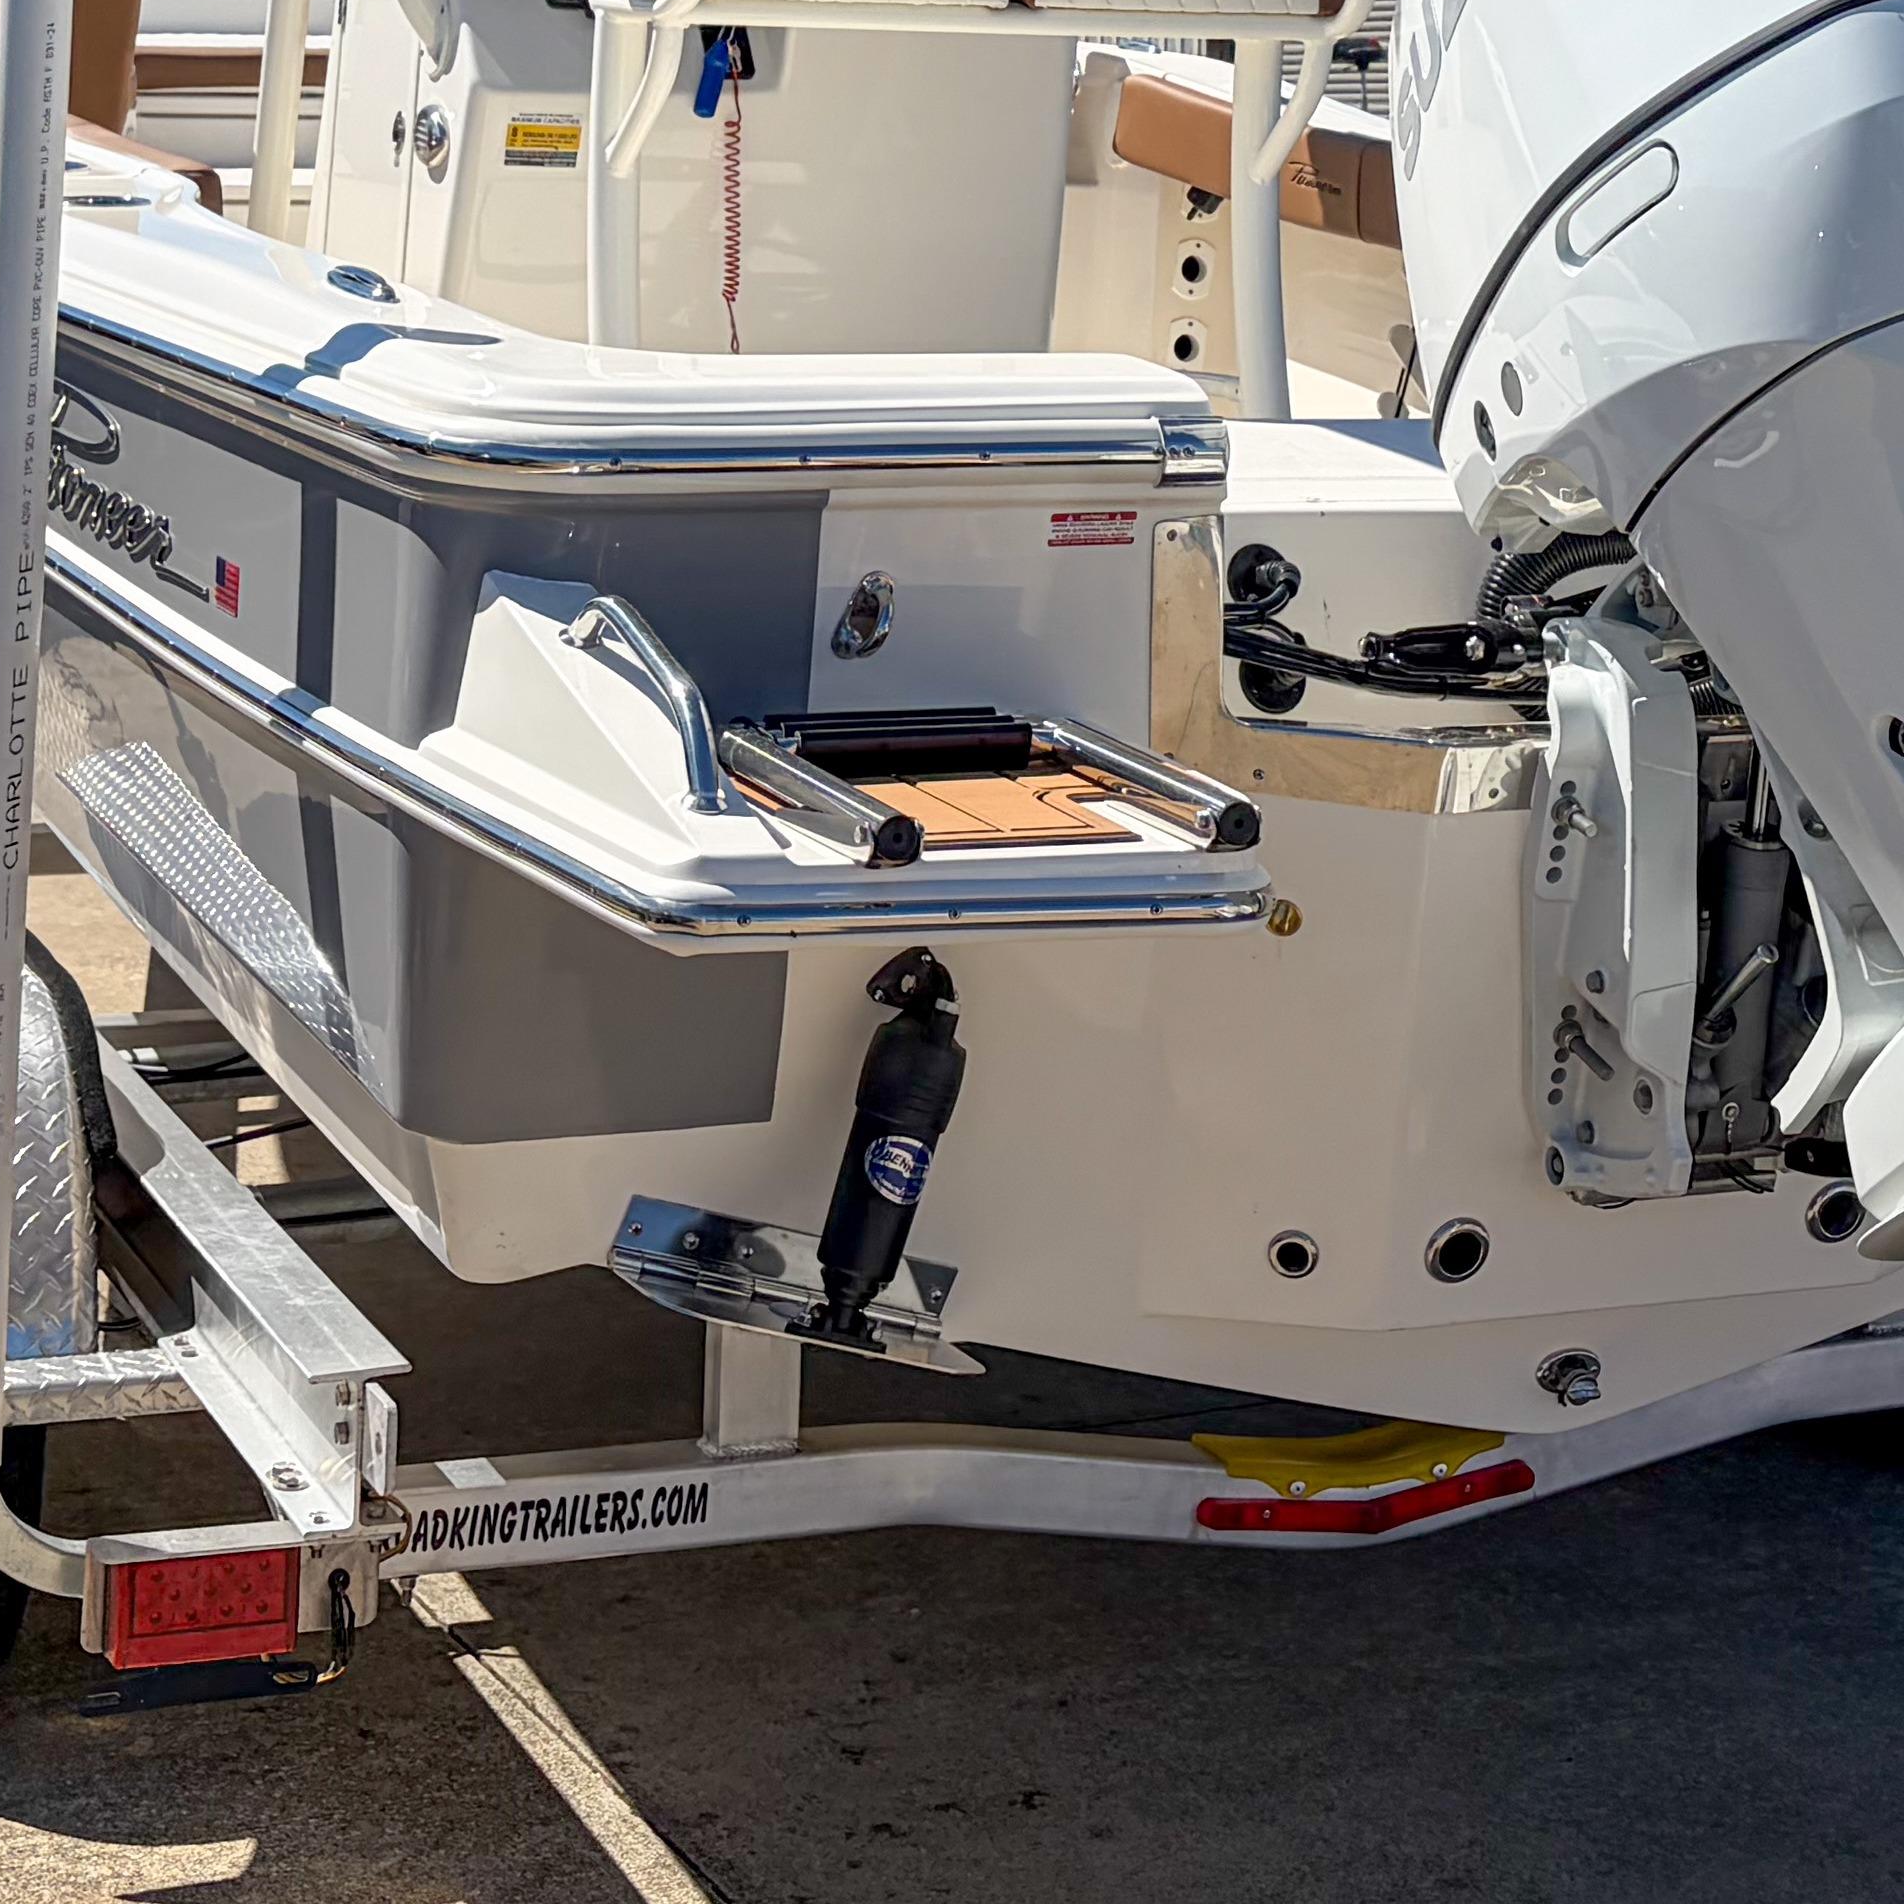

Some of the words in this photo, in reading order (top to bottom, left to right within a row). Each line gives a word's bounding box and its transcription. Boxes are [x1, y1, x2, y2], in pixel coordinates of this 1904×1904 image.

[41, 108, 51, 134] Code
[36, 215, 47, 241] PIPE
[14, 550, 34, 642] PIPE
[3, 665, 28, 870] CHARLOTTE
[379, 1482, 709, 1552] ADKINGTRAILERS.COM
